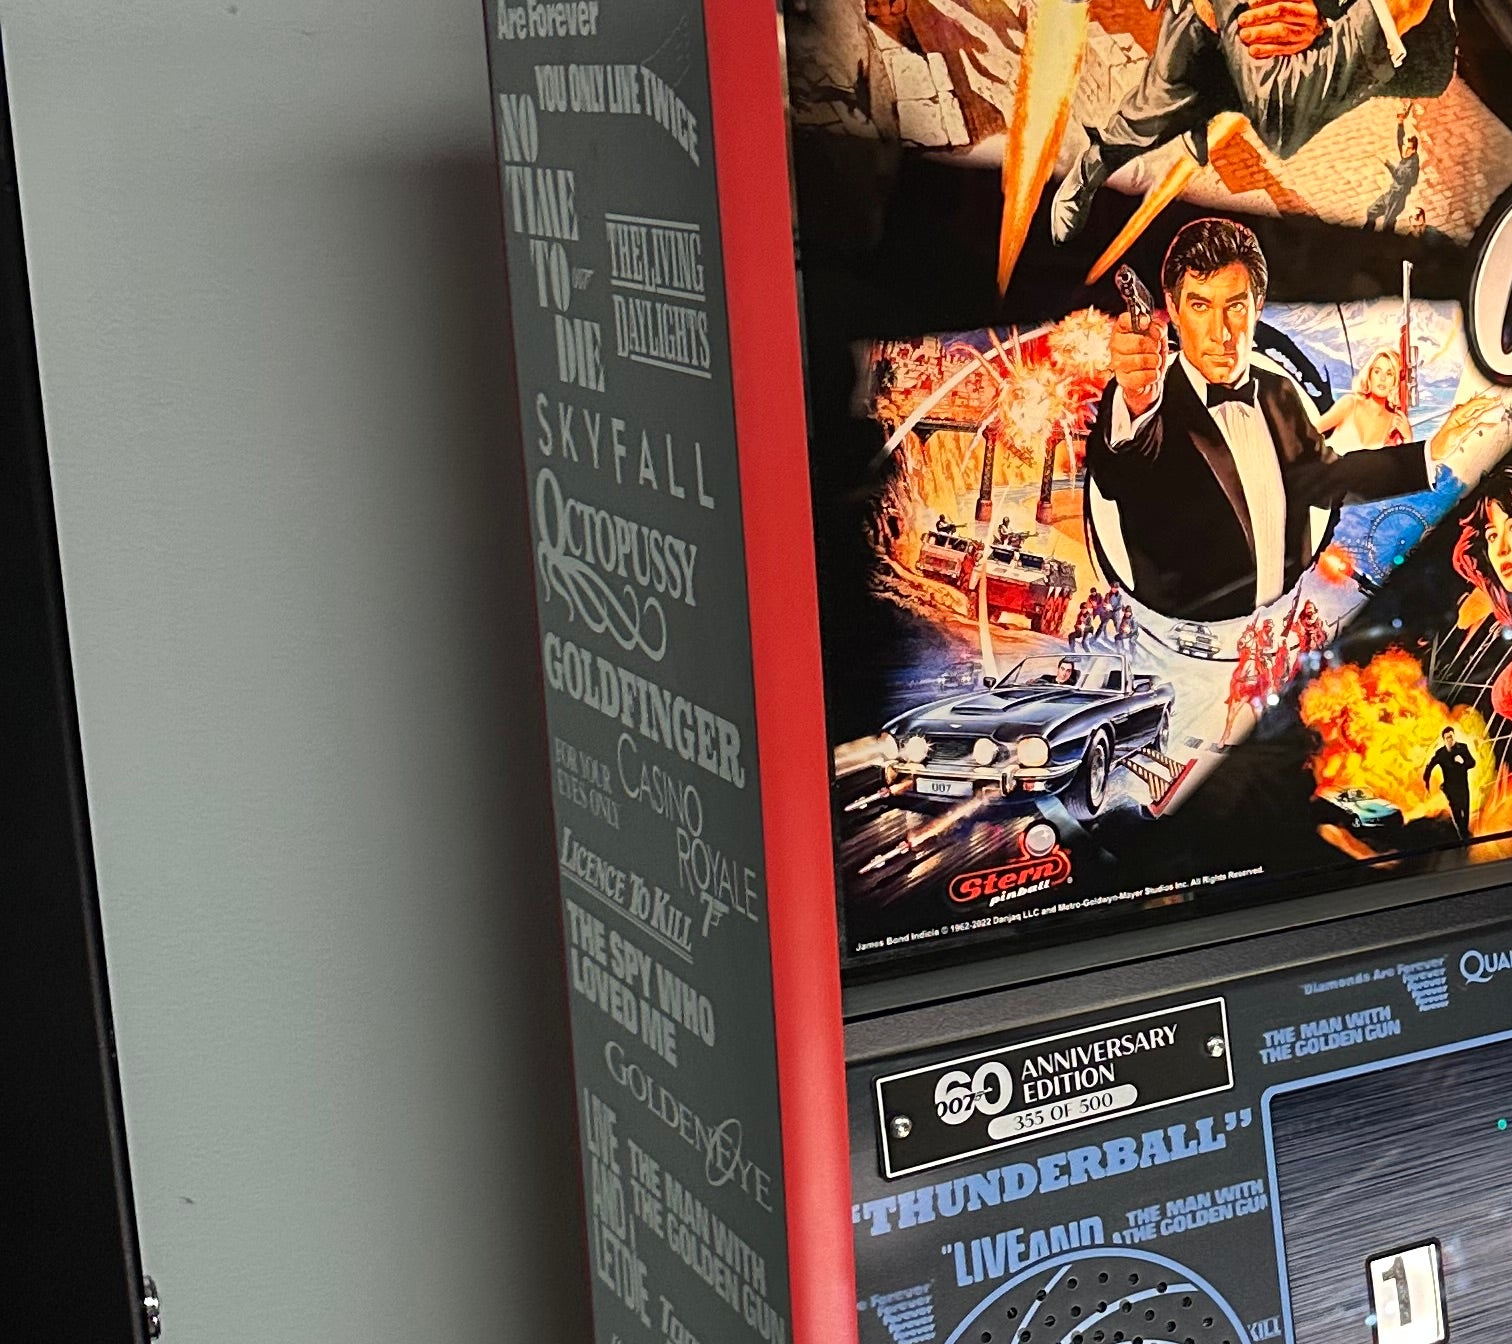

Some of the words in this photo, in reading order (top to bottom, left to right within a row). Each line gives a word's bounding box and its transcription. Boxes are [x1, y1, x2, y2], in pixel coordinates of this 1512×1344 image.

[499, 92, 539, 164] NO
[534, 64, 567, 112] YOU
[568, 64, 605, 113] ONLY
[606, 64, 641, 114] LIVE
[640, 64, 700, 167] TWICE
[505, 165, 579, 241] TIME
[529, 239, 572, 313] TO
[553, 314, 607, 393] DIE
[612, 294, 711, 369] DAYLIGHTS
[536, 392, 715, 509] SKYFALL
[535, 467, 697, 611] OCTOPUSSY
[544, 632, 745, 790] GOLDFINGER
[618, 733, 704, 838] CASINO
[560, 827, 626, 903] LICENCE
[651, 885, 693, 953] KILL
[677, 827, 759, 922] ROYALE
[955, 860, 1057, 900] Stern
[988, 879, 1051, 910] pinball
[567, 898, 606, 961] THE
[609, 929, 651, 997] SPY
[656, 963, 715, 1047] WHO
[572, 948, 638, 1035] LOVED
[640, 997, 678, 1068] ME
[1021, 1024, 1178, 1081] ANNIVERSARY
[1260, 1045, 1293, 1065] THE
[1295, 1027, 1365, 1057] GOLDEN
[1367, 1019, 1401, 1041] GUN
[1263, 1027, 1296, 1047] THE
[1300, 1017, 1344, 1039] MAN
[1347, 1006, 1391, 1028] WITH
[1013, 1110, 1046, 1132] 355
[1050, 1104, 1073, 1121] OF
[1079, 1092, 1113, 1114] 500
[1023, 1063, 1115, 1104] EDITION
[1126, 1209, 1162, 1227] THE
[1166, 1195, 1211, 1217] MAN
[1216, 1179, 1264, 1203] WITH
[1382, 1257, 1412, 1327] 1
